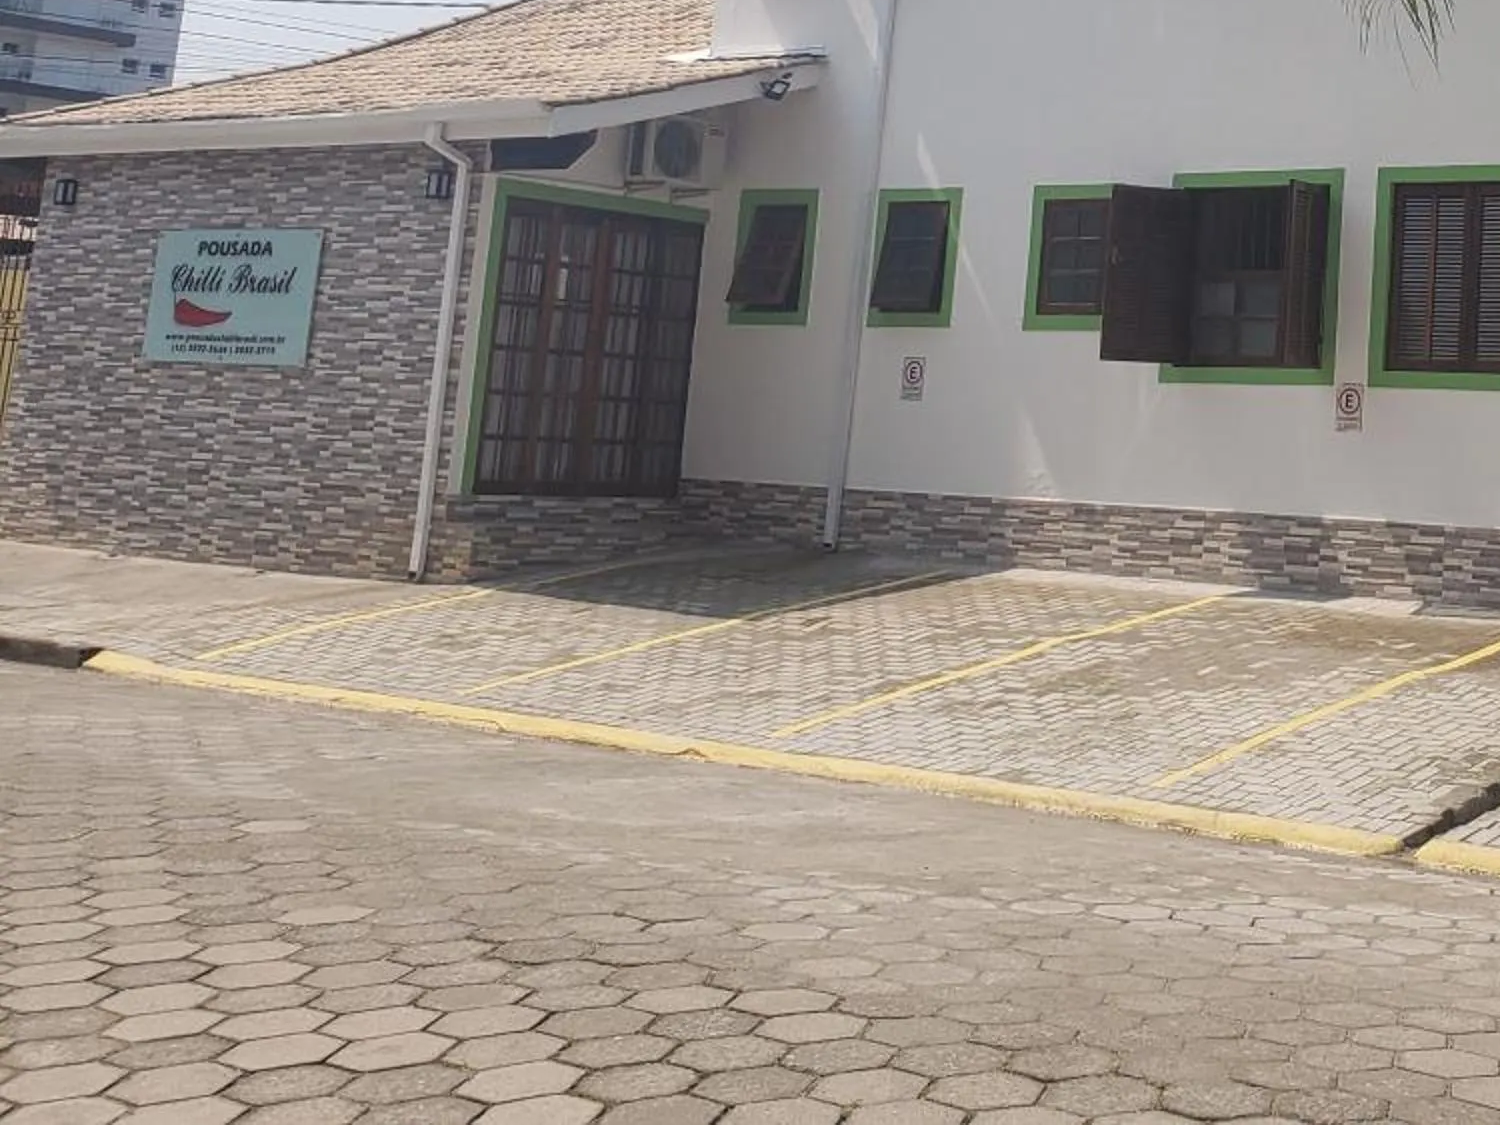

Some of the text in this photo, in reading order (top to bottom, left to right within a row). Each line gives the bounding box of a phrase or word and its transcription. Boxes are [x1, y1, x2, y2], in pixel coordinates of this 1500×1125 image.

[198, 241, 273, 257] POUSADA
[171, 263, 299, 294] Chilli Brasil
[909, 366, 918, 379] E
[1345, 394, 1354, 408] E
